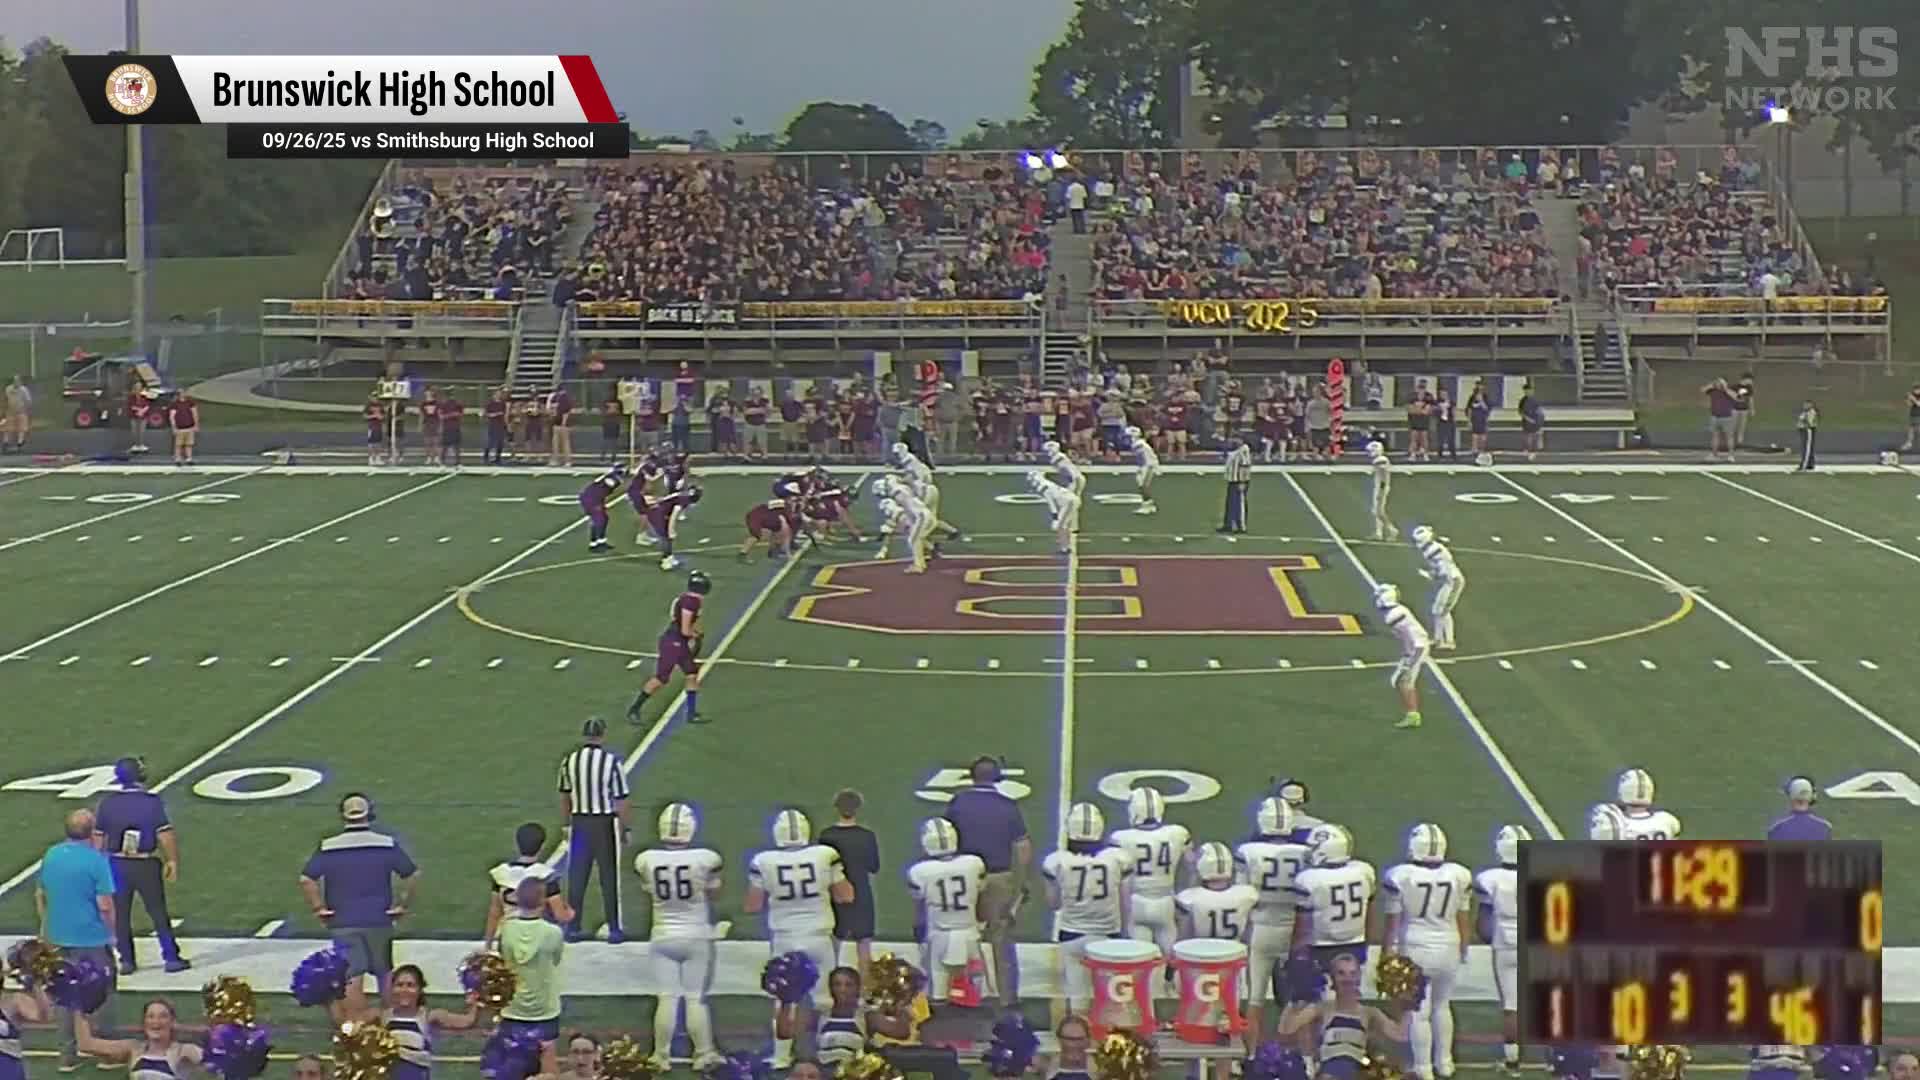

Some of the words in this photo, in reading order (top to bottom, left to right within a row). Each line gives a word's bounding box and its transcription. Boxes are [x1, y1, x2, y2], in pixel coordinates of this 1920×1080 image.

[1137, 842, 1171, 876] 24
[1262, 857, 1298, 890] 23
[654, 865, 693, 900] 66
[777, 863, 820, 900] 52
[937, 875, 968, 912] 12
[1071, 866, 1108, 901] 73
[1331, 881, 1363, 921] 55
[1417, 882, 1453, 918] 77
[1544, 882, 1572, 944] 0
[1209, 908, 1239, 940] 15
[1859, 890, 1882, 952] 0
[1107, 974, 1135, 1002] G
[1193, 974, 1220, 1002] G
[1668, 969, 1691, 1022] 3
[1726, 969, 1748, 1024] 3
[1611, 981, 1647, 1043] 10
